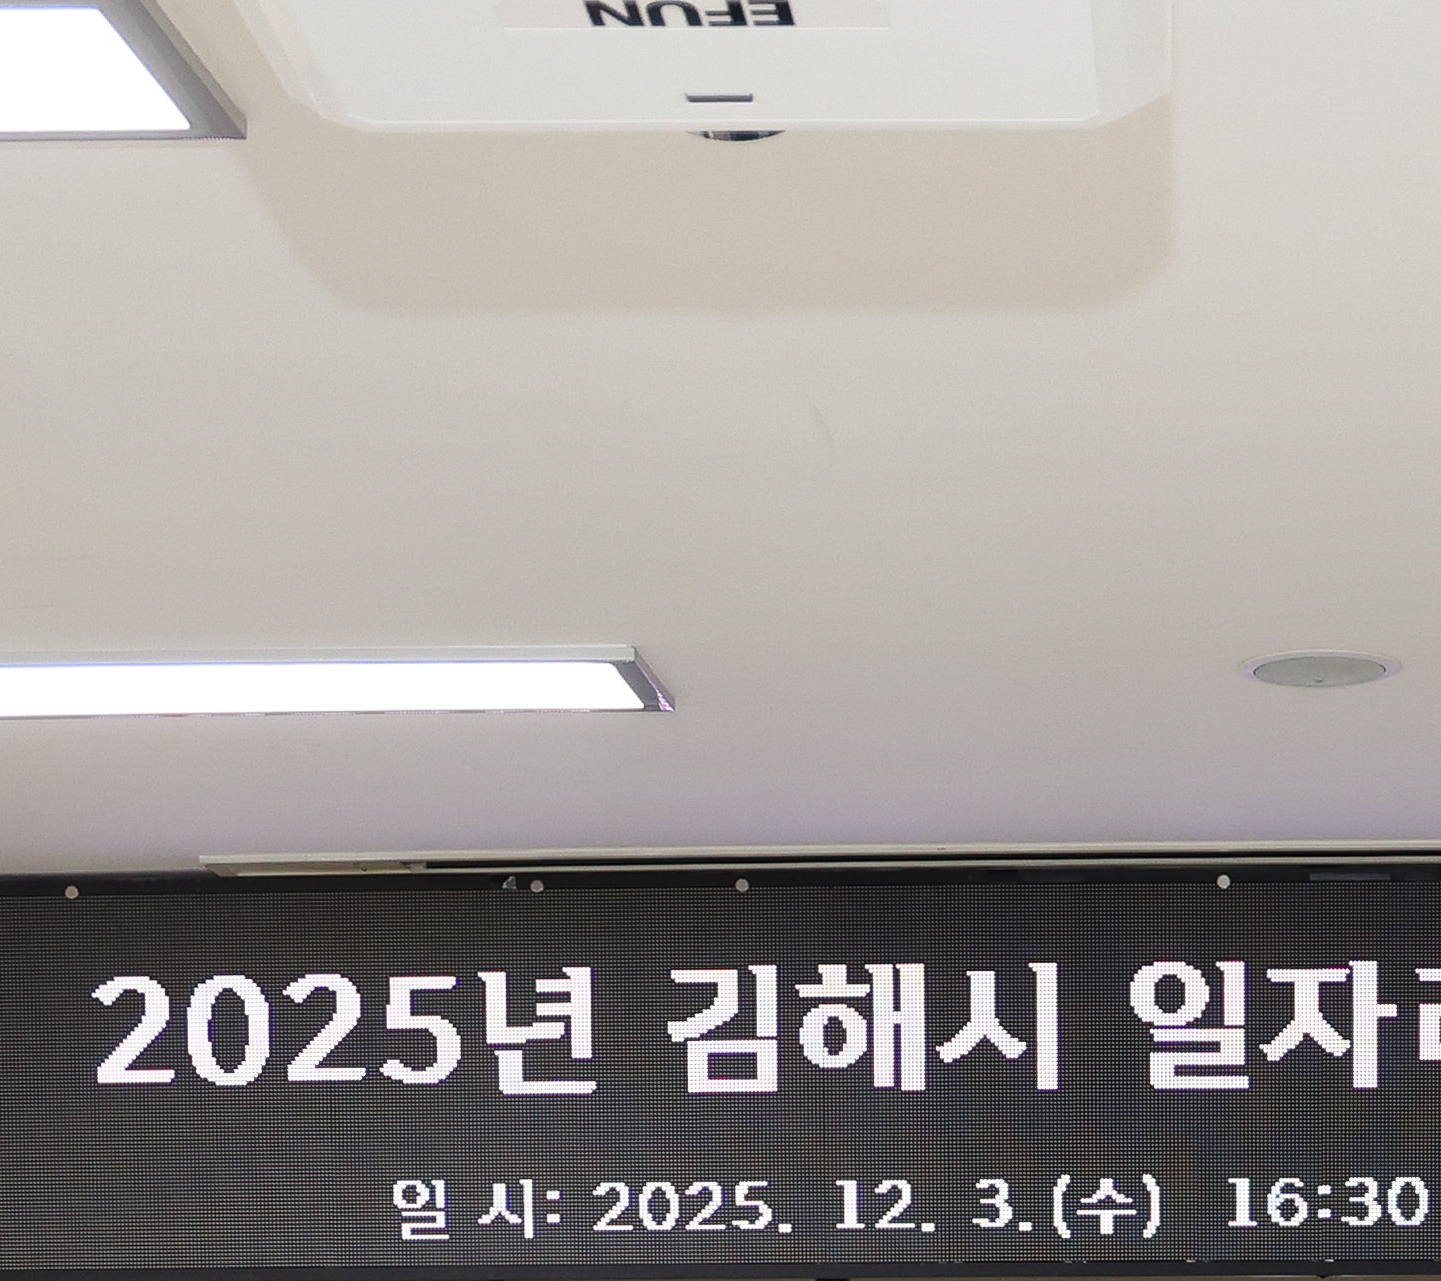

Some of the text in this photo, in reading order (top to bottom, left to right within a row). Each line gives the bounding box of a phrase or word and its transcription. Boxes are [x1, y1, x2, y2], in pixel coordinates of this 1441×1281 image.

[92, 965, 598, 1097] 2025년
[667, 962, 1060, 1095] 김해시
[593, 1180, 794, 1235] 2025.
[836, 1180, 937, 1234] 12.
[972, 1174, 1163, 1241] 3.(수)
[1229, 1177, 1431, 1229] 16:30
